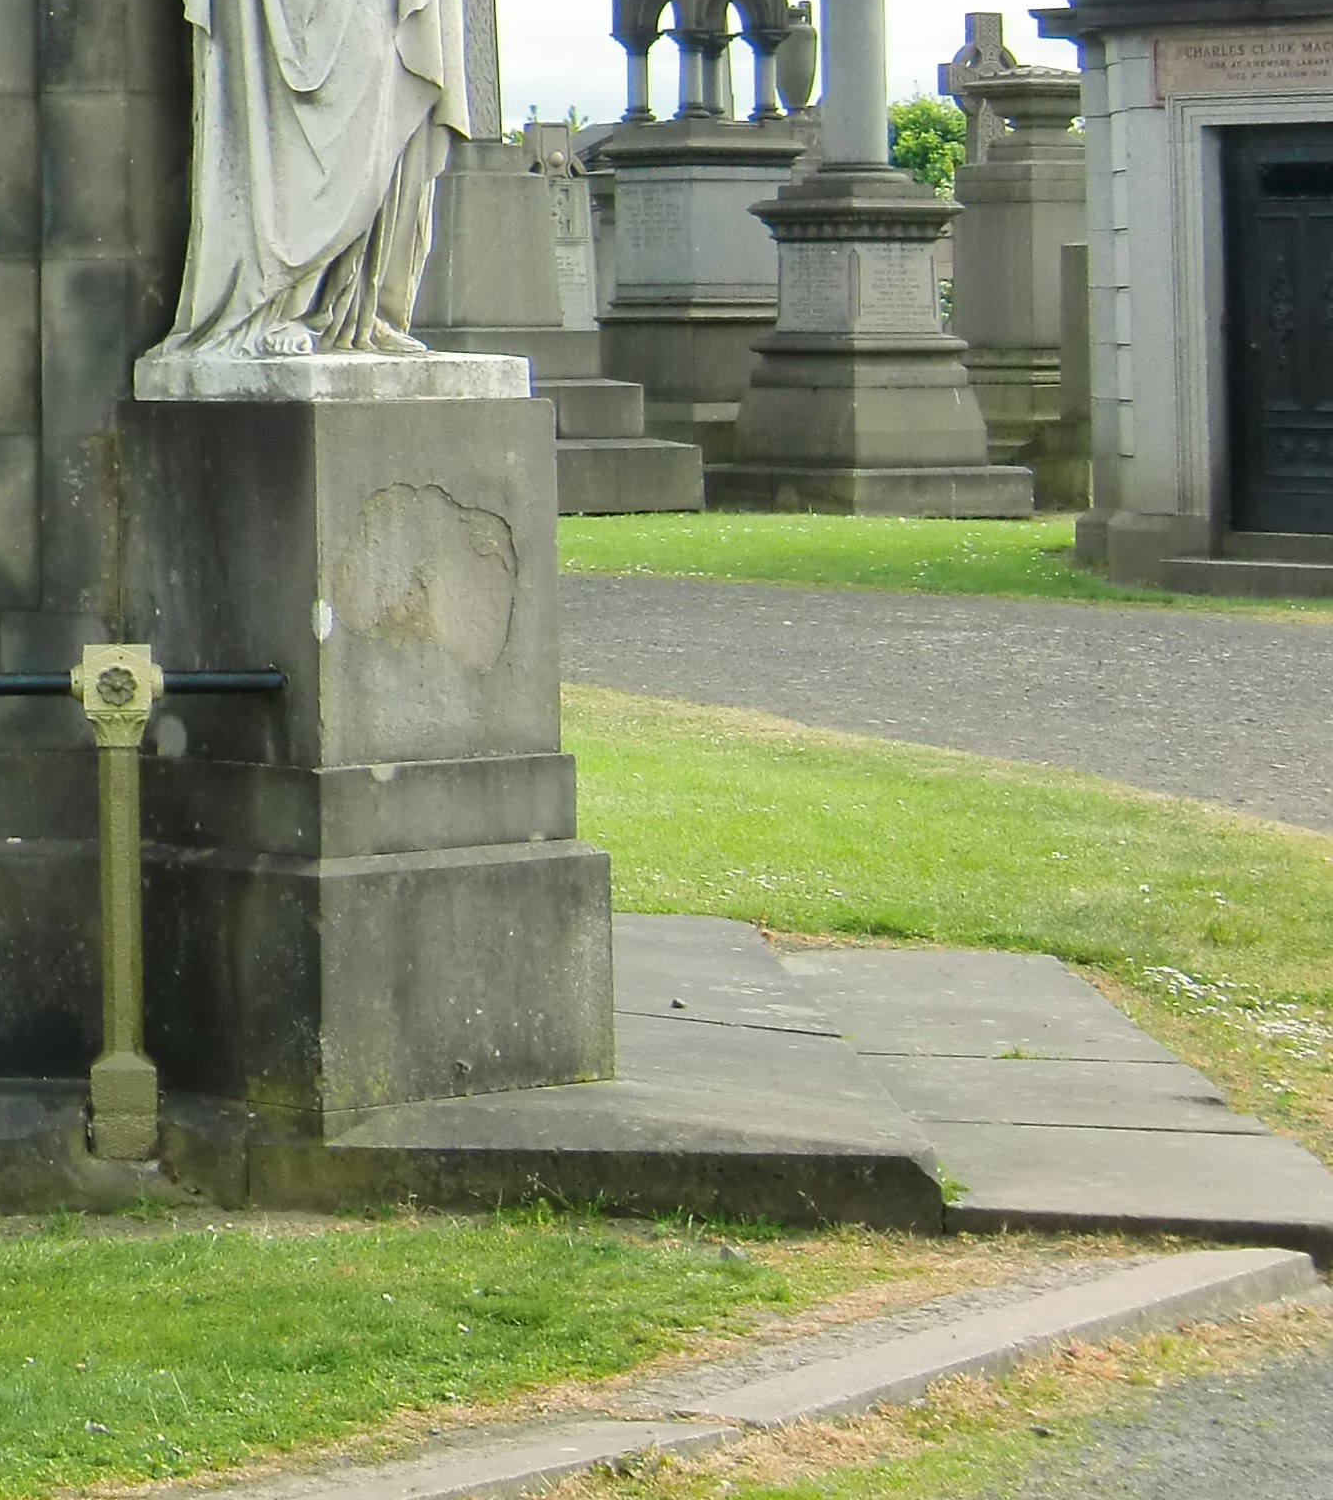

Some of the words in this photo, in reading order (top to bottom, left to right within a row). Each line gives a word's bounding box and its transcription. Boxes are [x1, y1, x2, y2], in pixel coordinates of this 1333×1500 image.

[1185, 45, 1245, 58] CHARLES
[1252, 43, 1295, 55] CLARK
[1301, 41, 1333, 53] MAC
